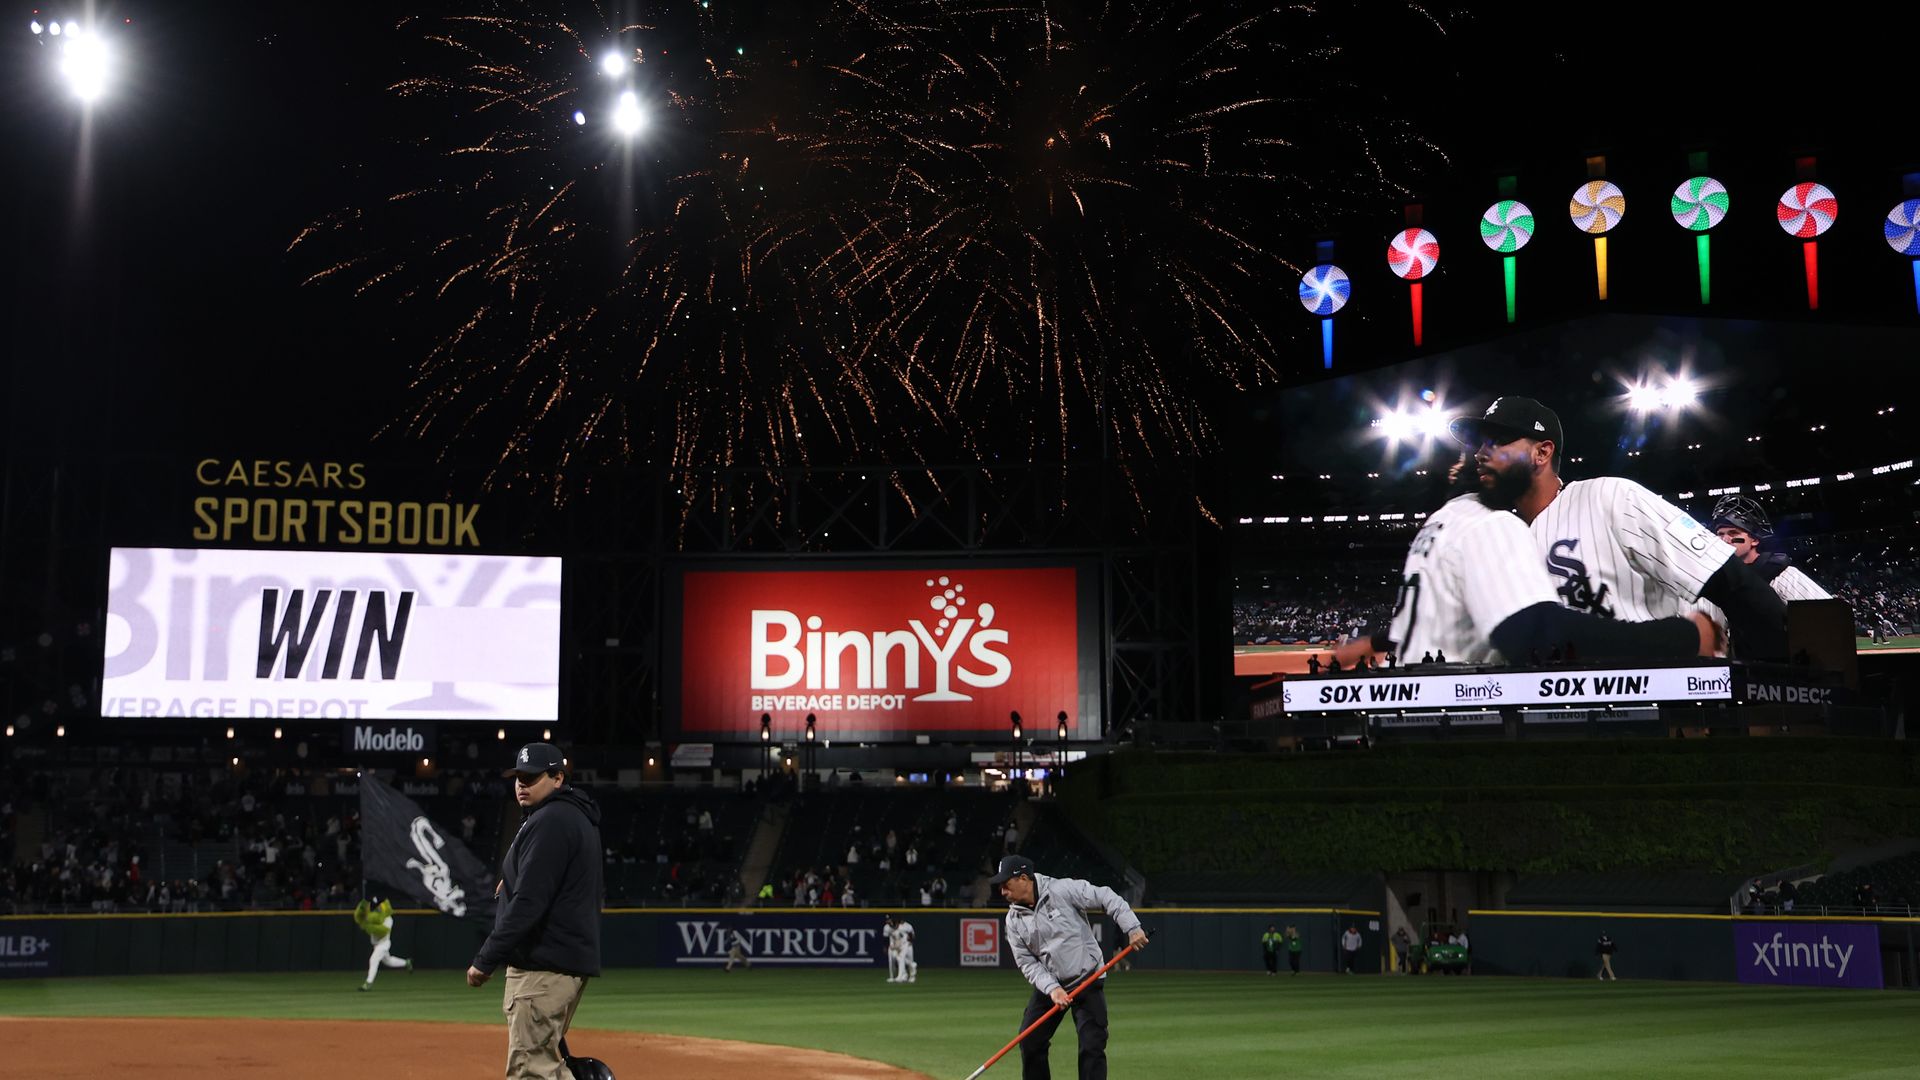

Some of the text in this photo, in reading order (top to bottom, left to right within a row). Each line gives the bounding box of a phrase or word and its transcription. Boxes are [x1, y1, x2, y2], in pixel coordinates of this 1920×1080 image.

[196, 458, 367, 489] CAESARS
[193, 496, 481, 546] SPORTSBOOK
[255, 587, 417, 681] WIN
[1319, 683, 1421, 704] SOX WIN!
[1539, 676, 1649, 697] SOX WIN!
[1746, 683, 1781, 702] FAN
[752, 694, 906, 711] BEVERAGE DEPOT
[354, 725, 424, 751] Modelo
[676, 921, 876, 956] WINTRUST
[1752, 932, 1854, 978] xfinity
